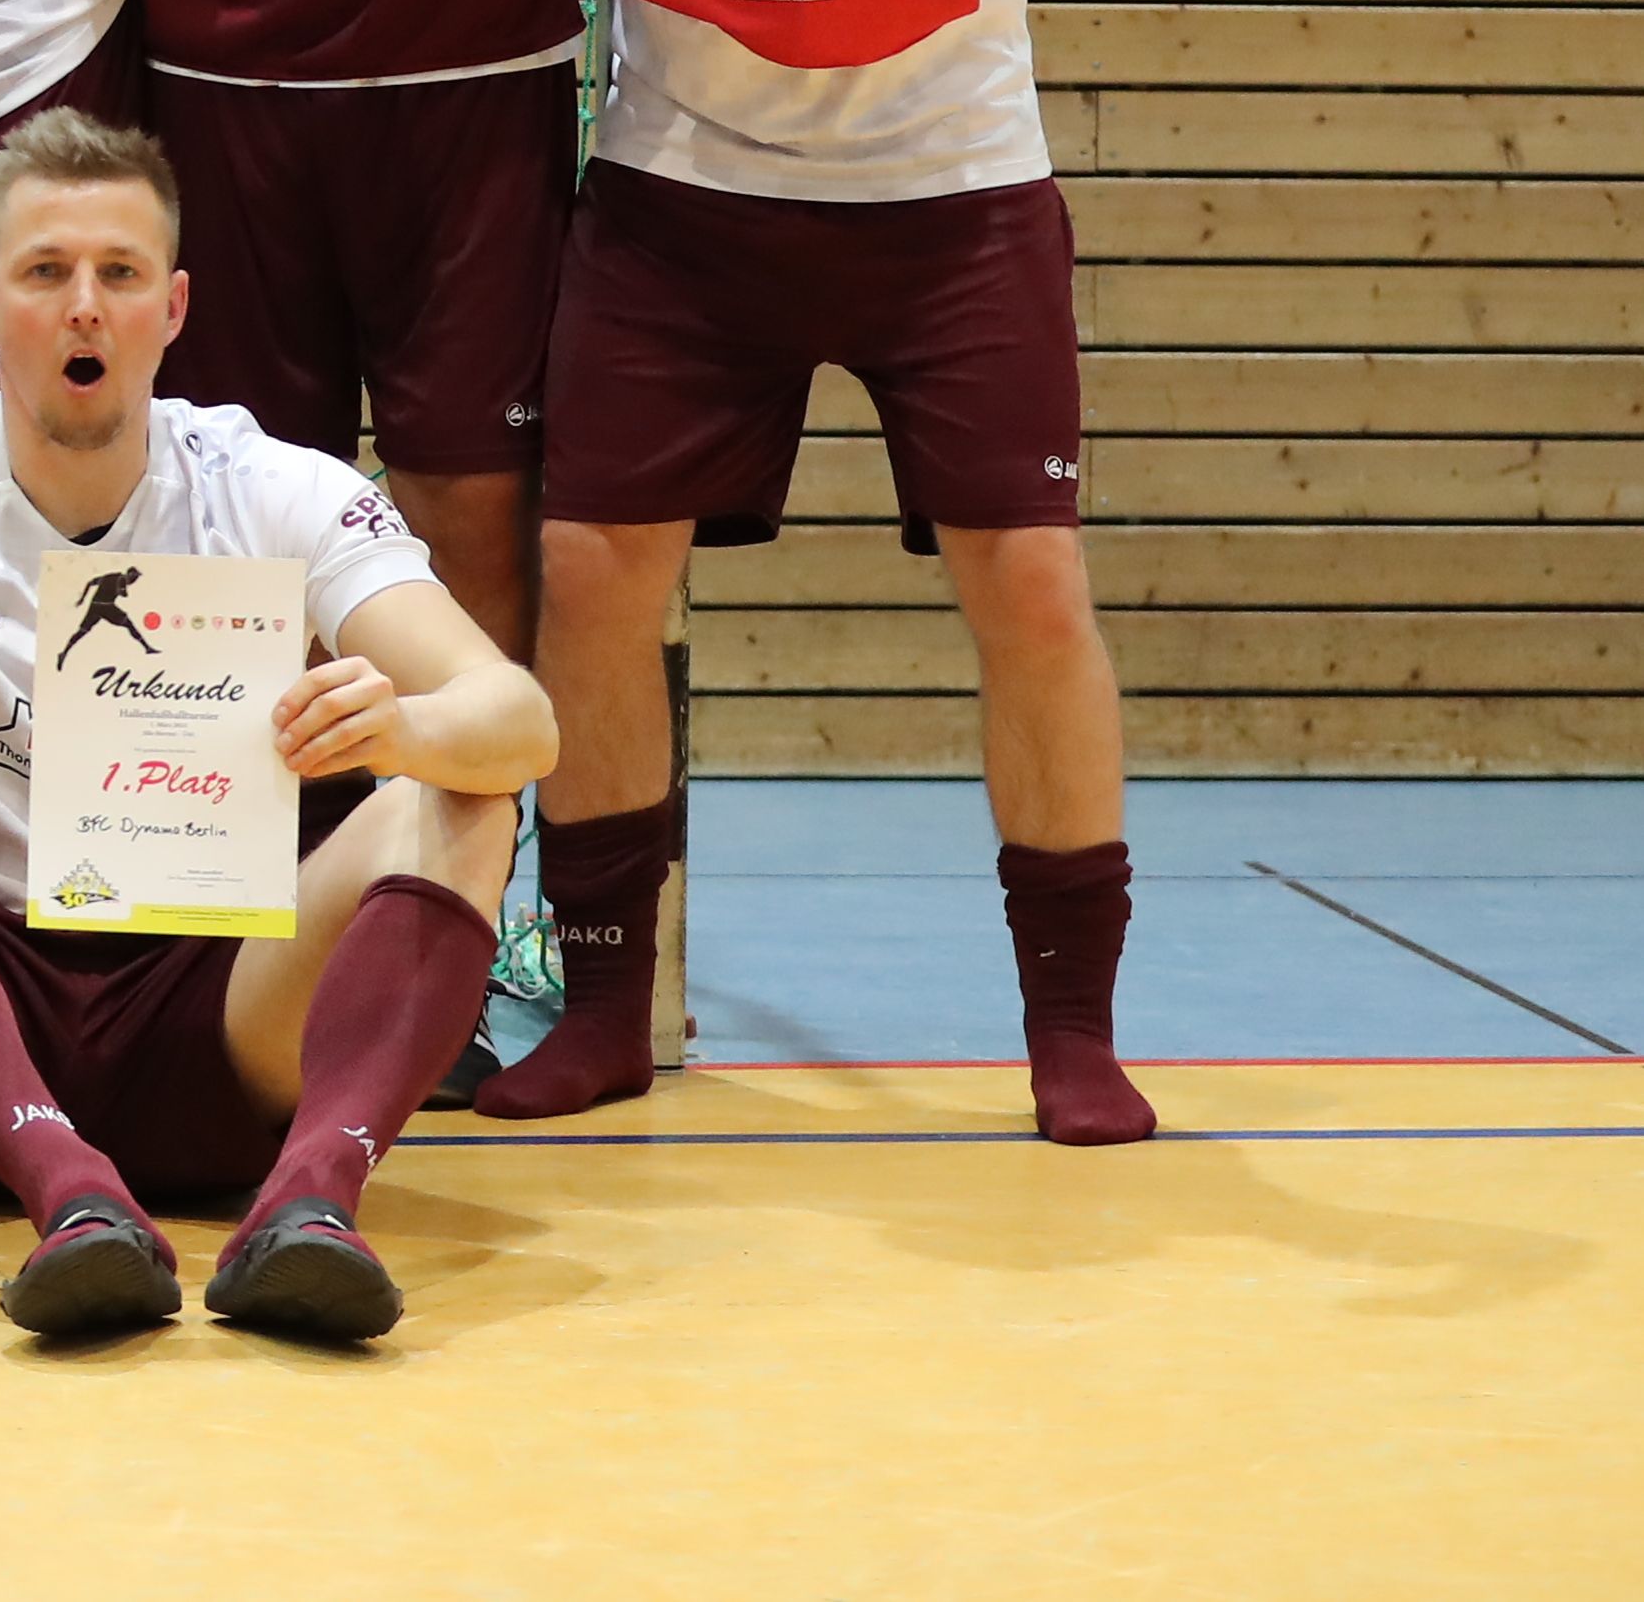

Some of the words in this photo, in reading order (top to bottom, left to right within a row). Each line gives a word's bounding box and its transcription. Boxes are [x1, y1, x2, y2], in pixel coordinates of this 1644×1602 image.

[91, 665, 246, 702] Urkunde
[76, 814, 114, 835] BFC
[119, 816, 181, 843] Dynamo
[184, 822, 229, 839] Berlin
[61, 892, 87, 907] 30
[557, 924, 625, 945] JAKO
[11, 1103, 76, 1132] JAKO
